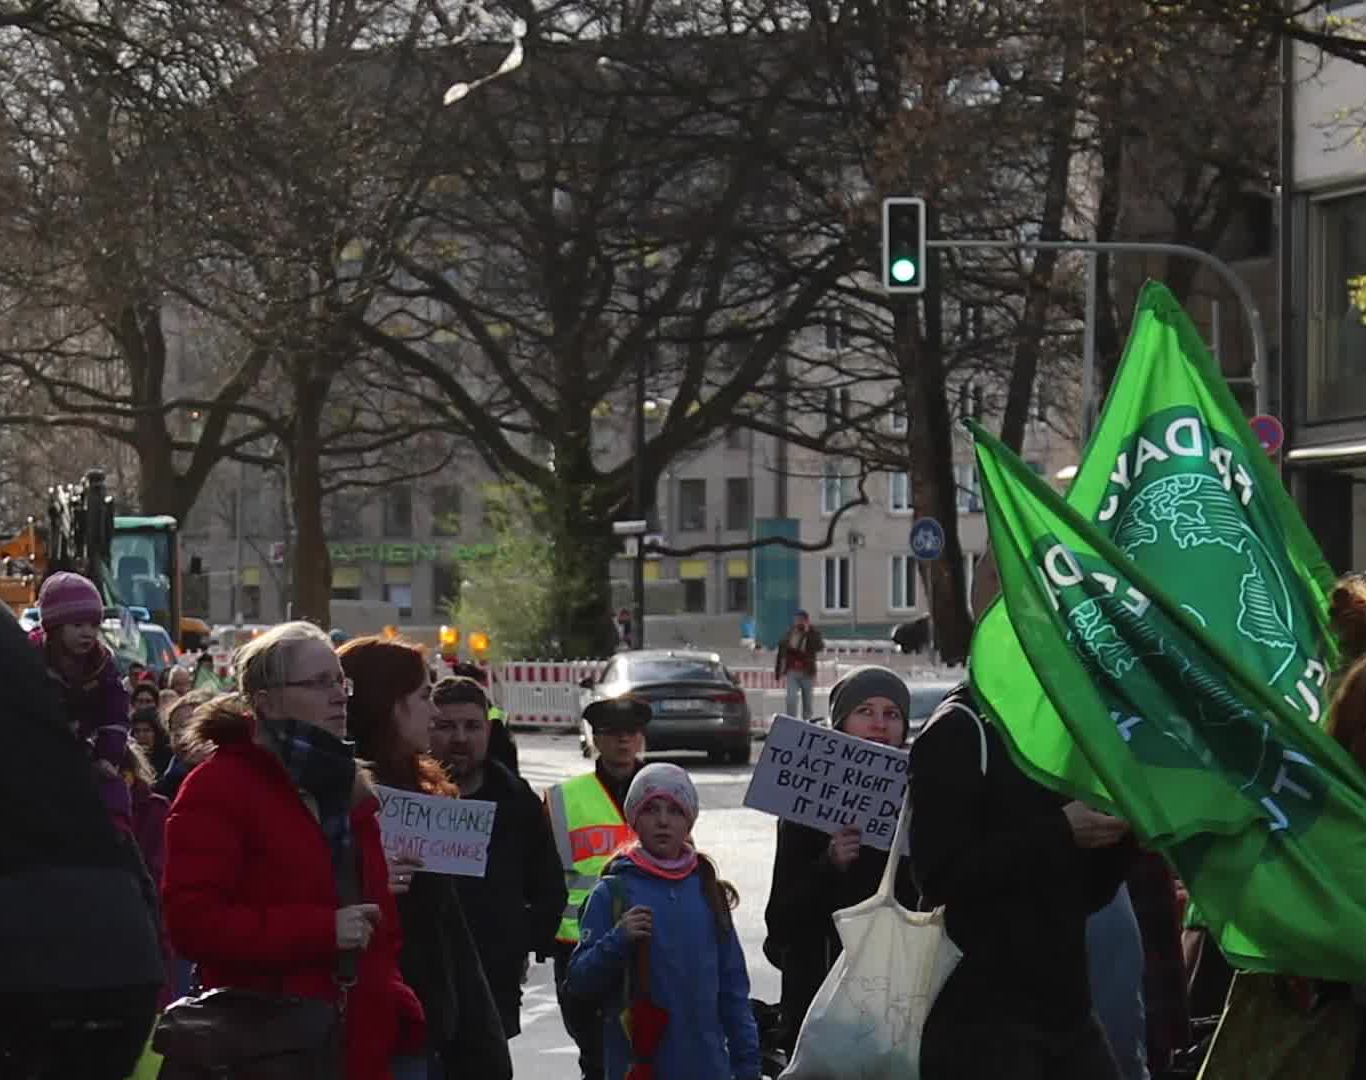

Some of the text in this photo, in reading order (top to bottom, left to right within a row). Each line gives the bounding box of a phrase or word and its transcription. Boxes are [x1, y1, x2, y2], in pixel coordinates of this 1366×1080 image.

[770, 747, 793, 765] TO
[796, 755, 835, 777] ACT
[842, 768, 894, 794] RIGHT
[798, 731, 909, 774] IT'S NOT TO
[777, 769, 816, 793] BUT
[819, 783, 840, 799] IF
[841, 791, 872, 813] WE
[377, 792, 495, 836] YSTEM CHANGE
[792, 796, 814, 815] IT
[866, 818, 890, 836] BE
